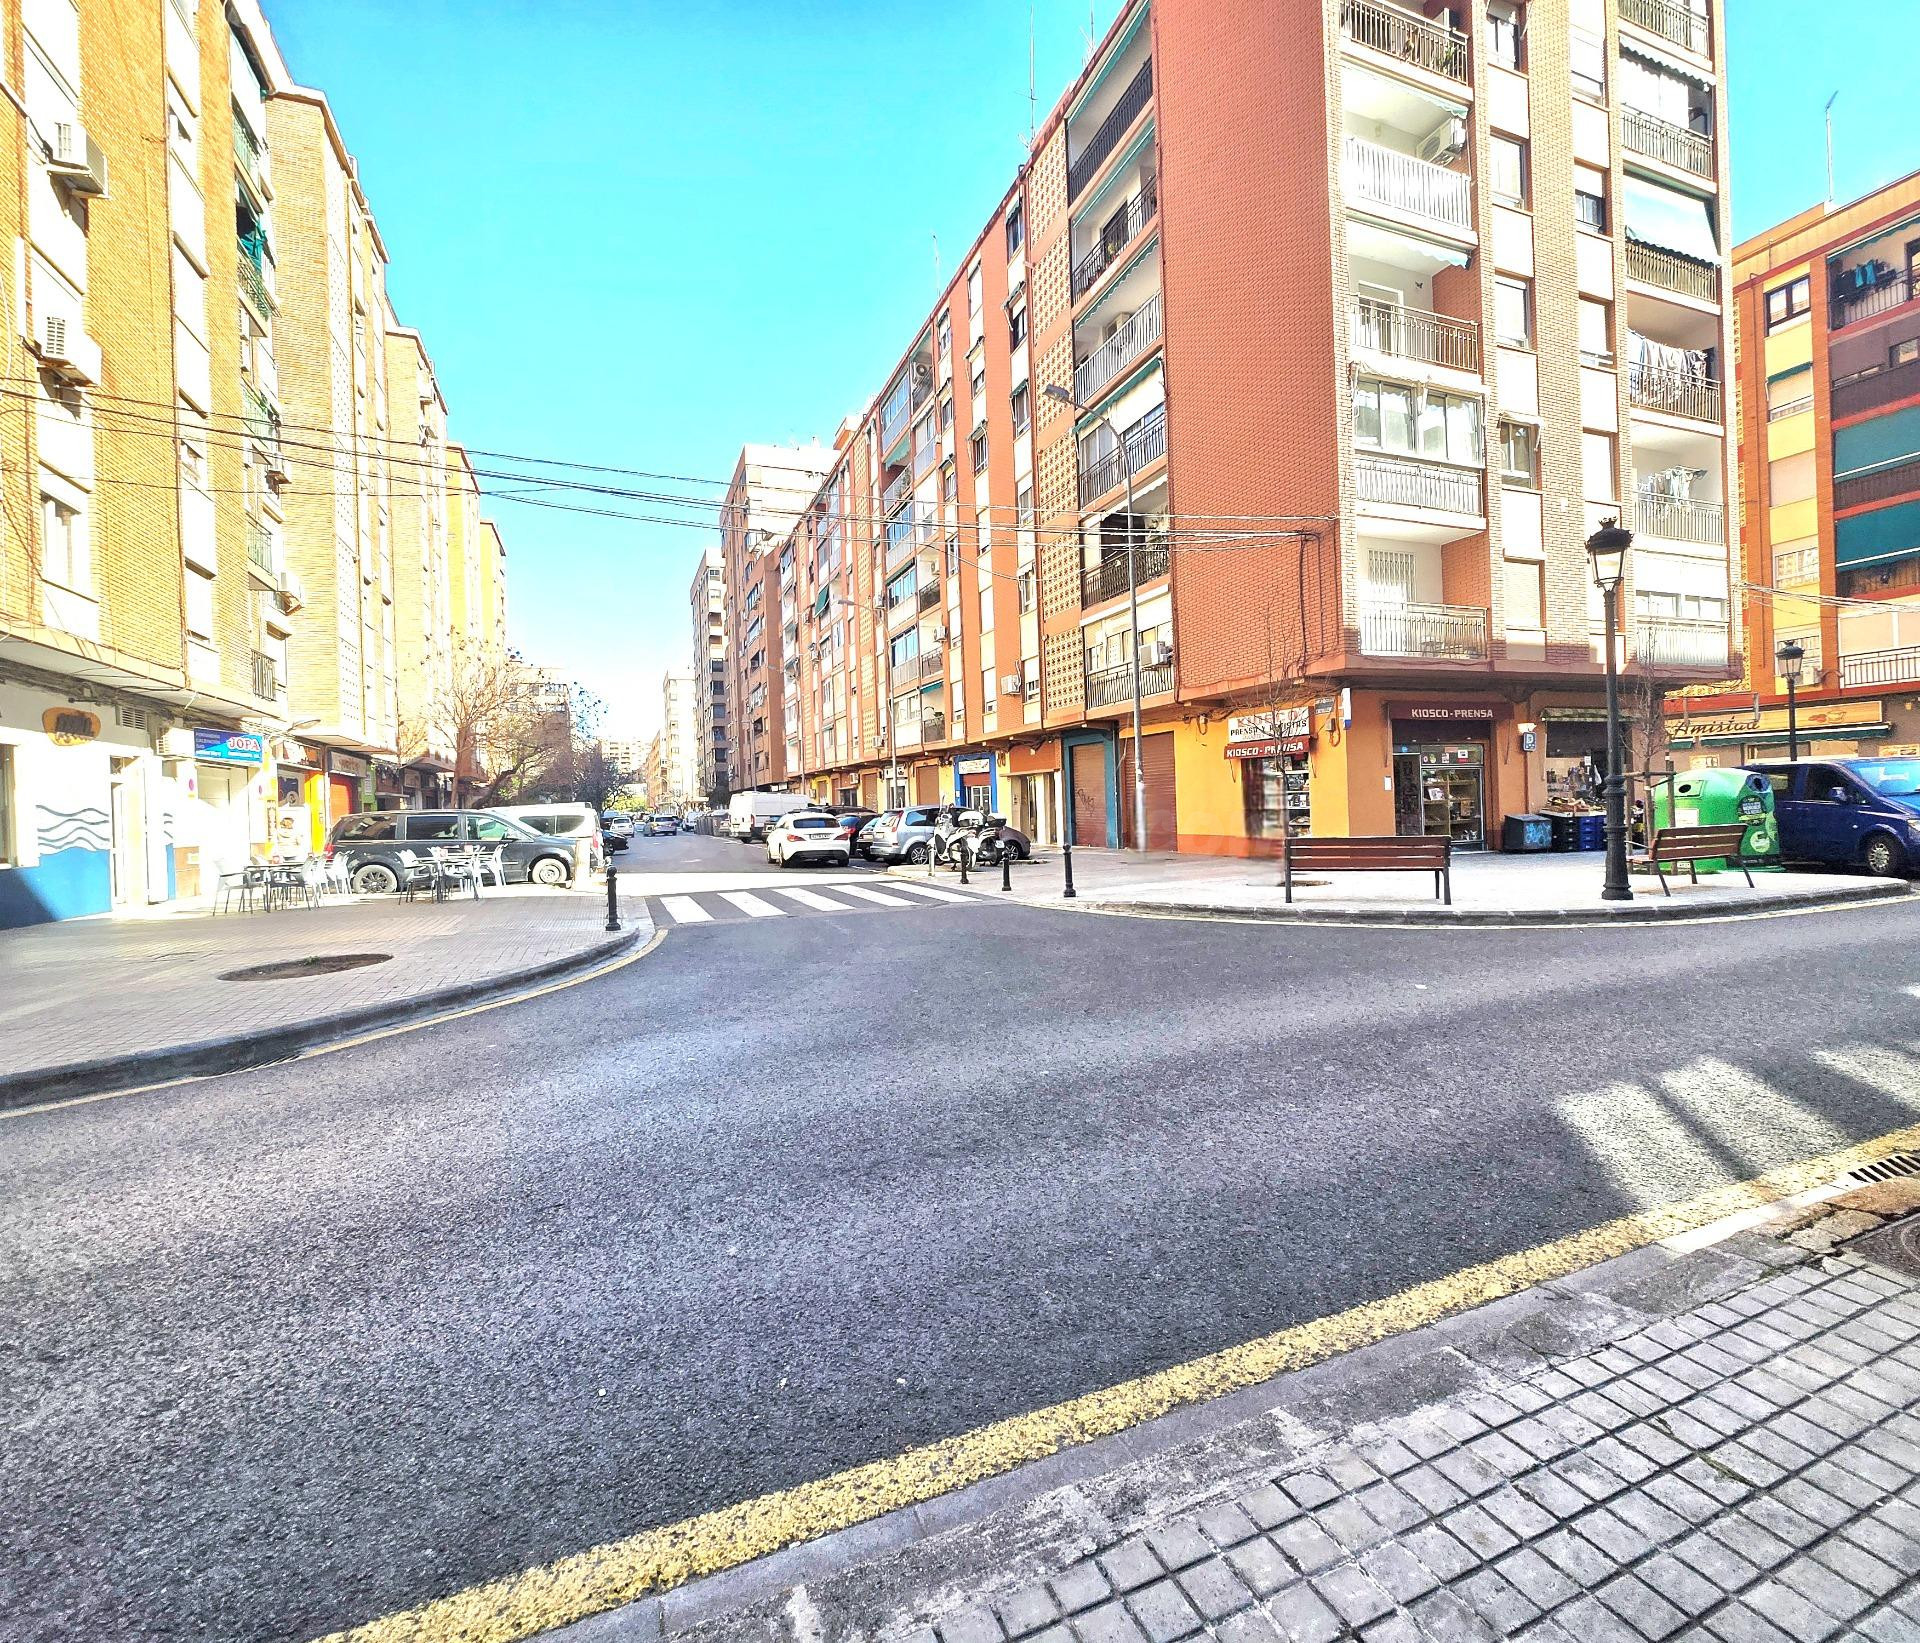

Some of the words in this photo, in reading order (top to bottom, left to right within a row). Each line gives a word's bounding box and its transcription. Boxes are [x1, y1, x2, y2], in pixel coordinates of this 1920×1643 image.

[1454, 709, 1494, 718] PRENSA
[227, 737, 260, 751] JOPA
[1227, 748, 1259, 757] KIOSCO
